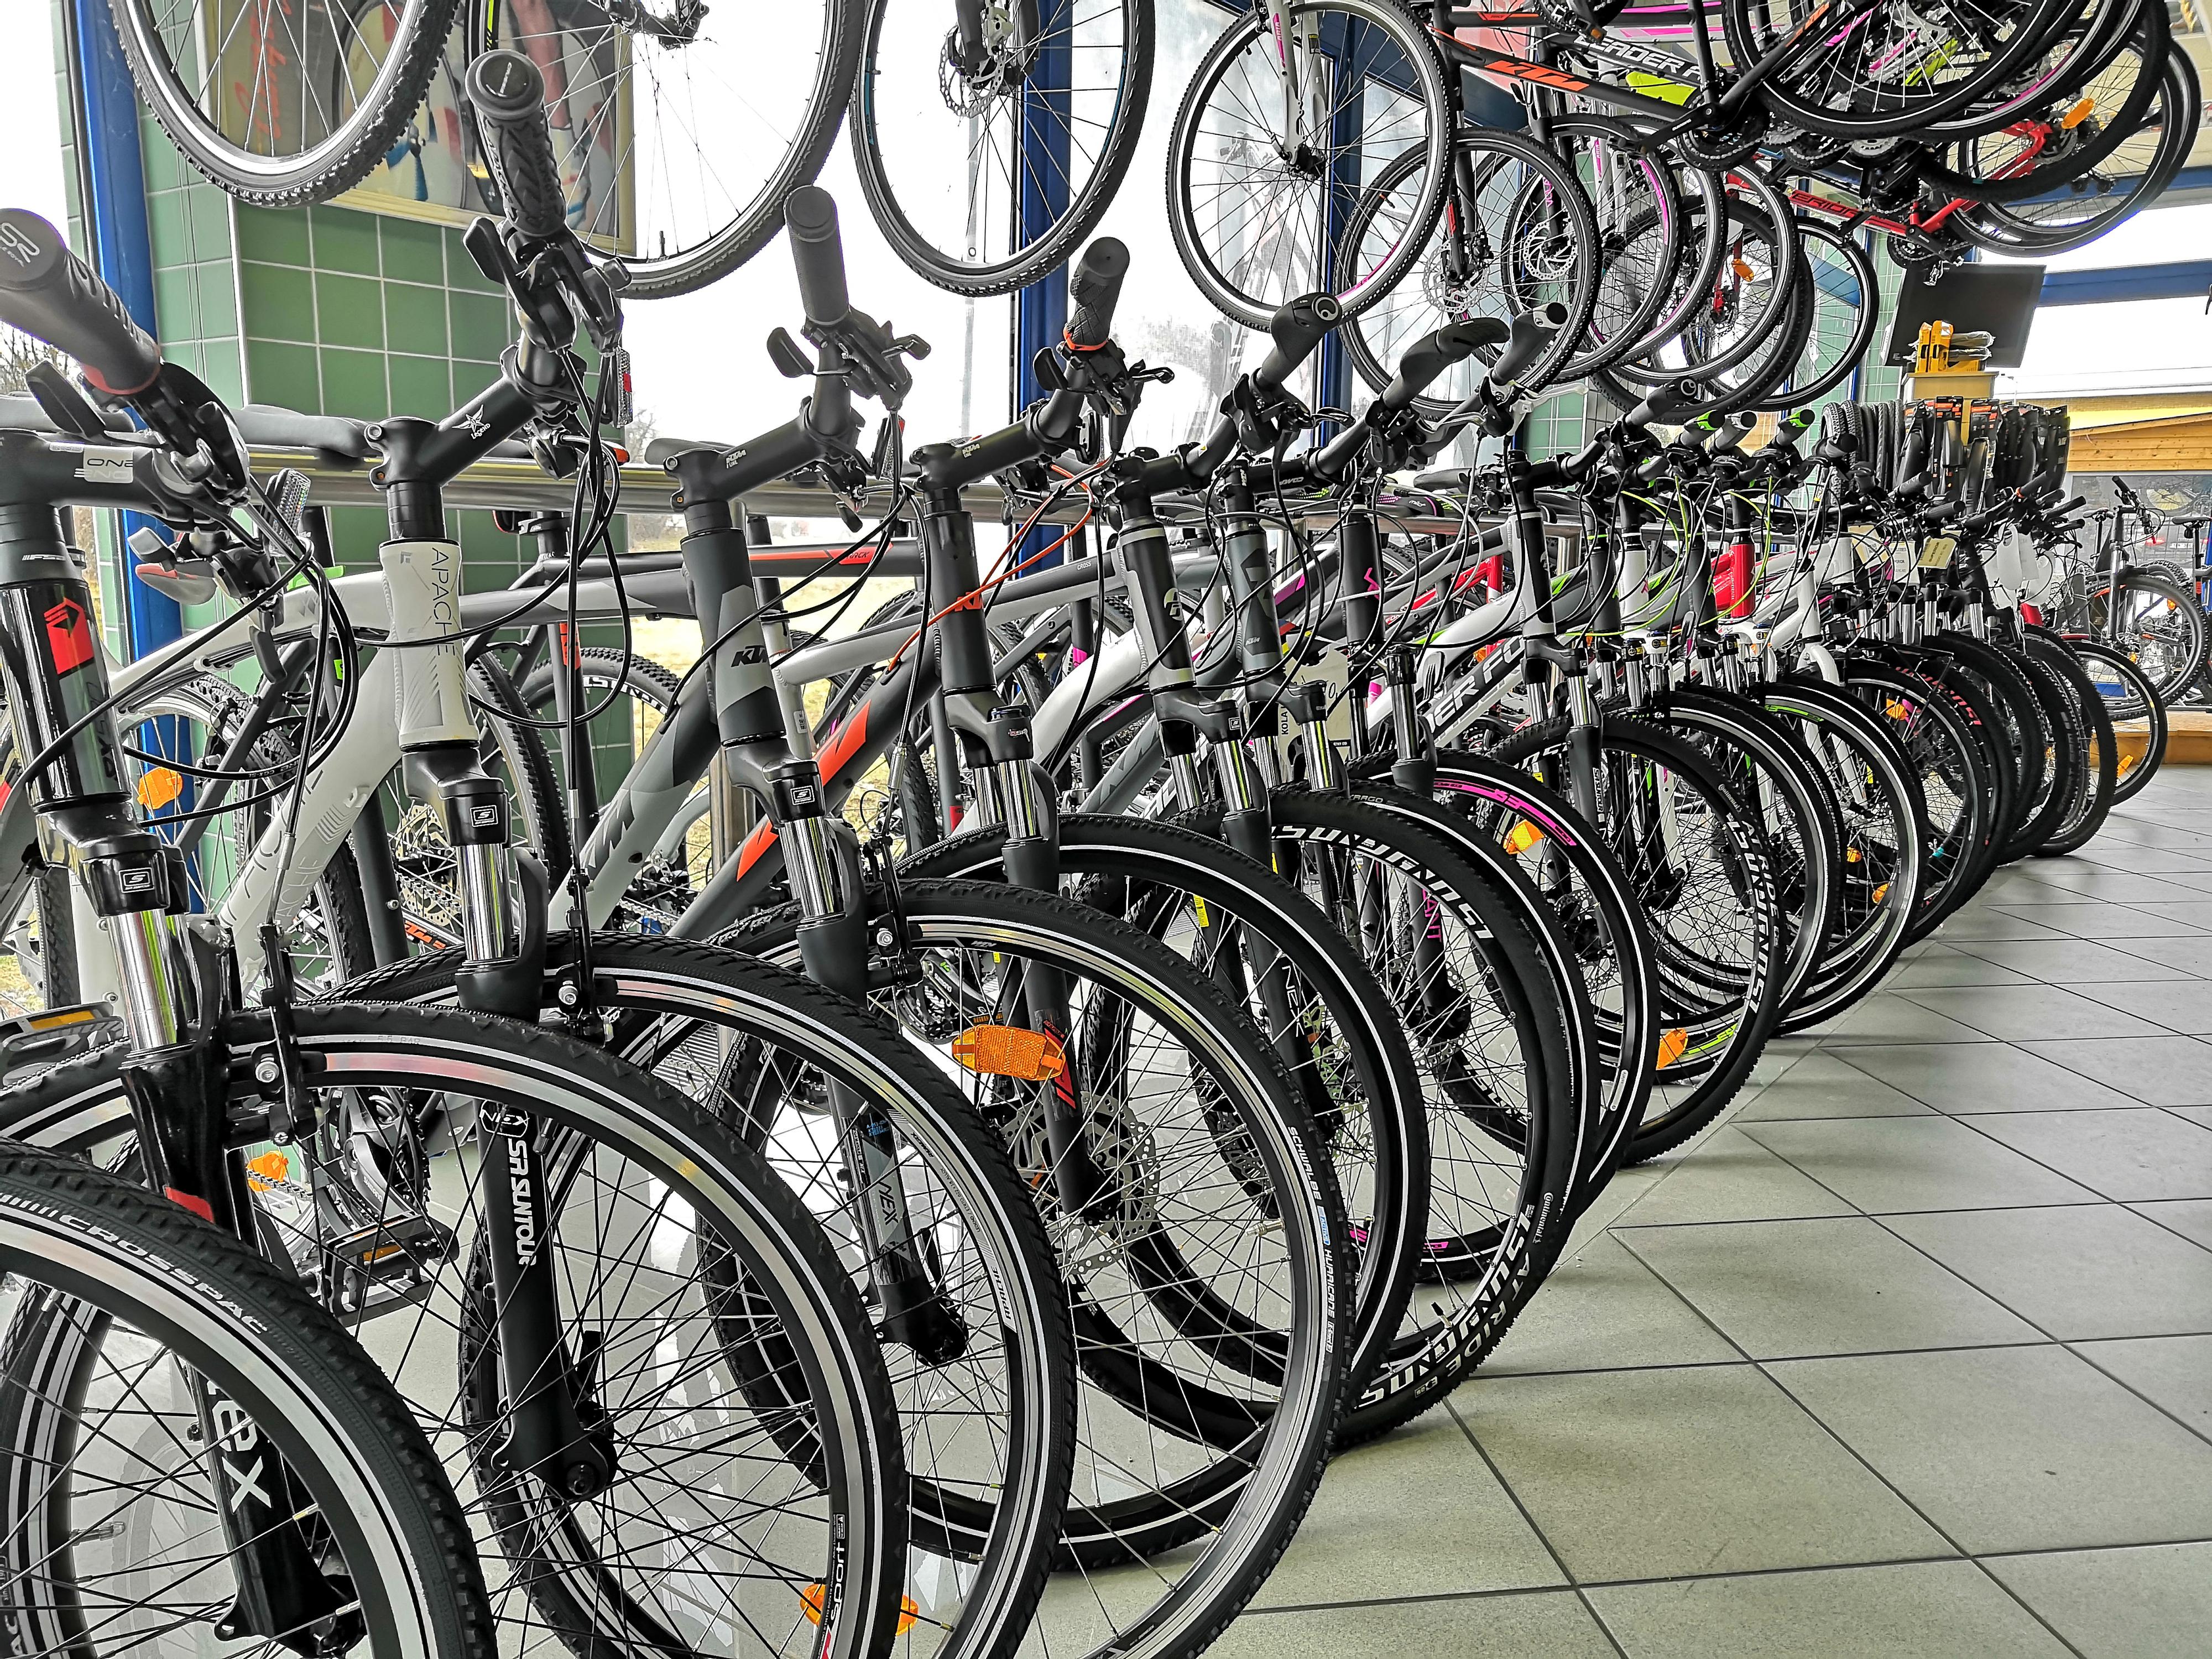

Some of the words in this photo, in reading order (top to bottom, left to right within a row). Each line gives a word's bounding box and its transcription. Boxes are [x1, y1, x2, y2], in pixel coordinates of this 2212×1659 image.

[1077, 561, 1091, 570] CROSS
[431, 547, 456, 656] APACHE
[954, 591, 982, 612] KT
[1280, 706, 1288, 735] KOLA
[1594, 780, 1604, 812] SUNTOUR
[1804, 760, 1824, 792] IMPAC
[1741, 820, 1762, 849] AT
[1758, 854, 1780, 921] RIDE
[933, 972, 952, 993] SHIMANO
[1282, 965, 1306, 1037] NEX
[508, 1138, 528, 1176] SR
[940, 1167, 952, 1181] ALLOY
[364, 1176, 383, 1202] SHIMANO
[873, 1179, 898, 1226] NEX
[960, 1197, 971, 1215] ETRTO
[511, 1178, 536, 1266] SUNTOUR
[970, 1215, 981, 1233] LEGEND
[1287, 1125, 1322, 1201] SCHWALBE
[1324, 1250, 1335, 1318] HURRICANE
[1536, 1192, 1553, 1239] Continental
[58, 1211, 268, 1333] CROSSPAC
[991, 1265, 1012, 1321] APACHE
[1508, 1252, 1530, 1303] AT
[1446, 1300, 1508, 1376] RIDE
[830, 1542, 845, 1622] sport
